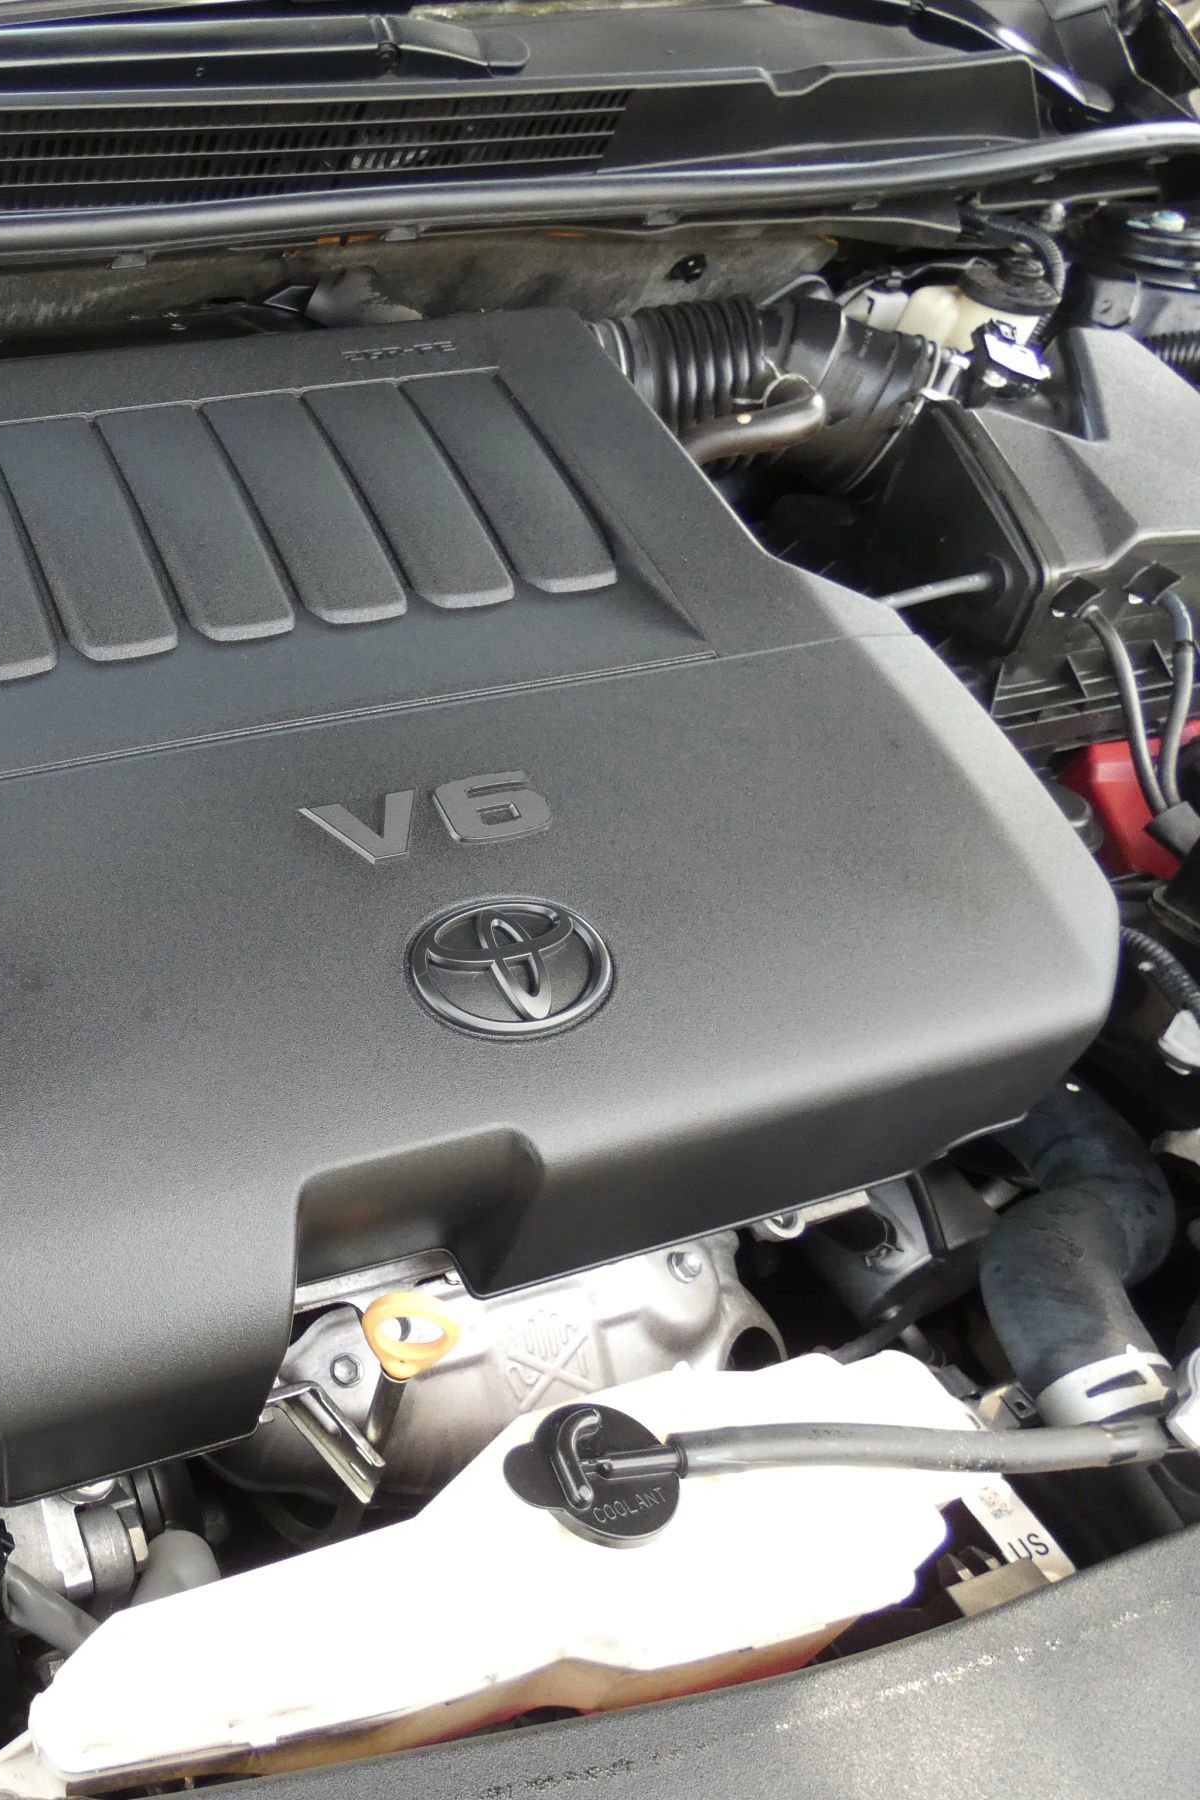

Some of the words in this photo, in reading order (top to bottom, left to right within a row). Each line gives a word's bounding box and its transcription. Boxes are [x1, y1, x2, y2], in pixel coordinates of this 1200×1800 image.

[298, 769, 551, 864] V6
[592, 1487, 666, 1523] COOLANT
[1008, 1533, 1050, 1560] US
